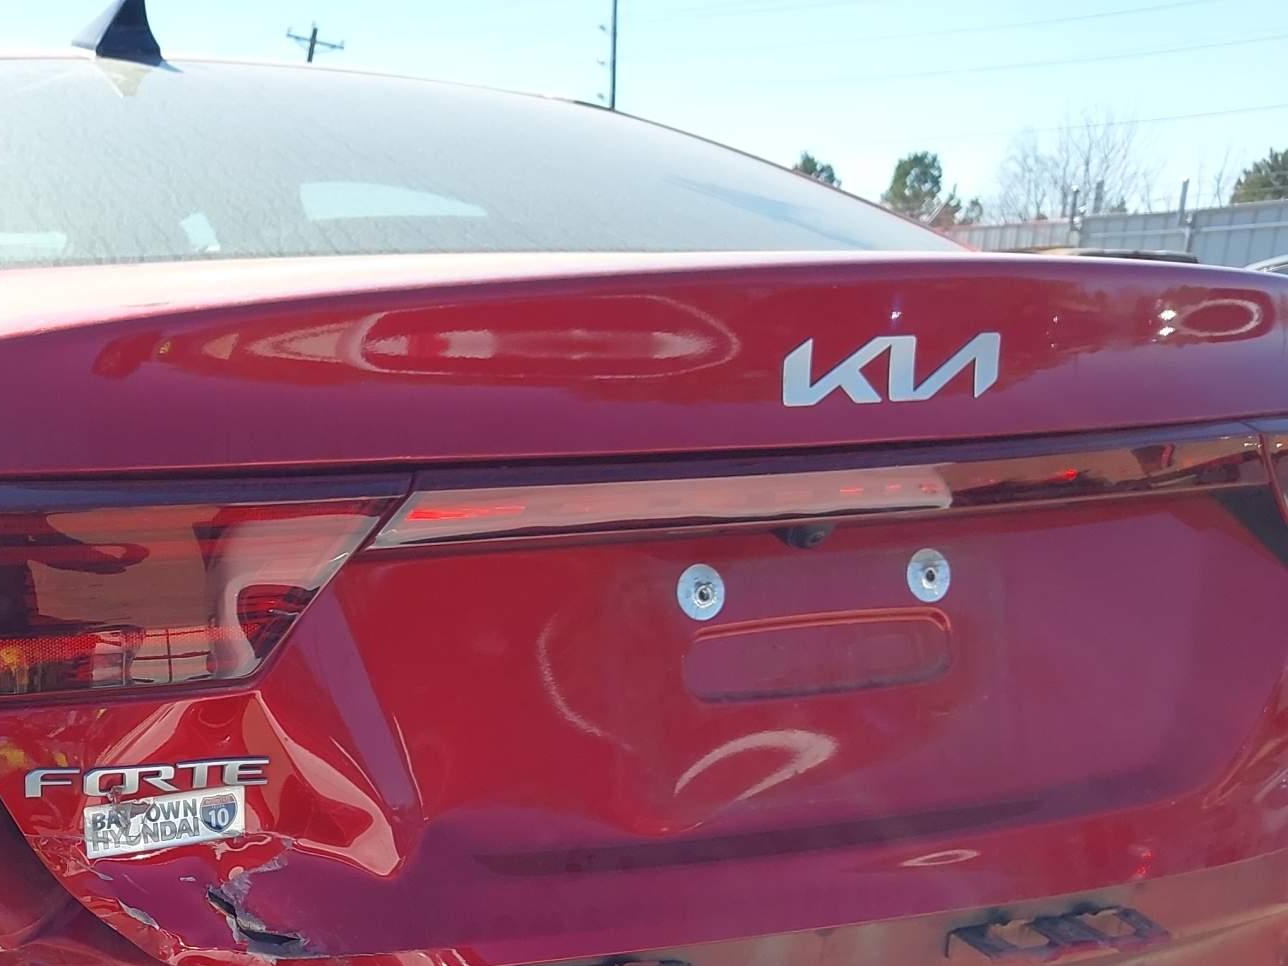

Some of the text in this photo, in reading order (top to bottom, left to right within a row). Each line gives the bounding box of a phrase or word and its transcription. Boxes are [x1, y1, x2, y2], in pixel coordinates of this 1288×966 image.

[783, 332, 1001, 407] KIA
[24, 756, 270, 798] FORTE
[91, 799, 198, 832] BAOWN
[209, 806, 230, 828] 10
